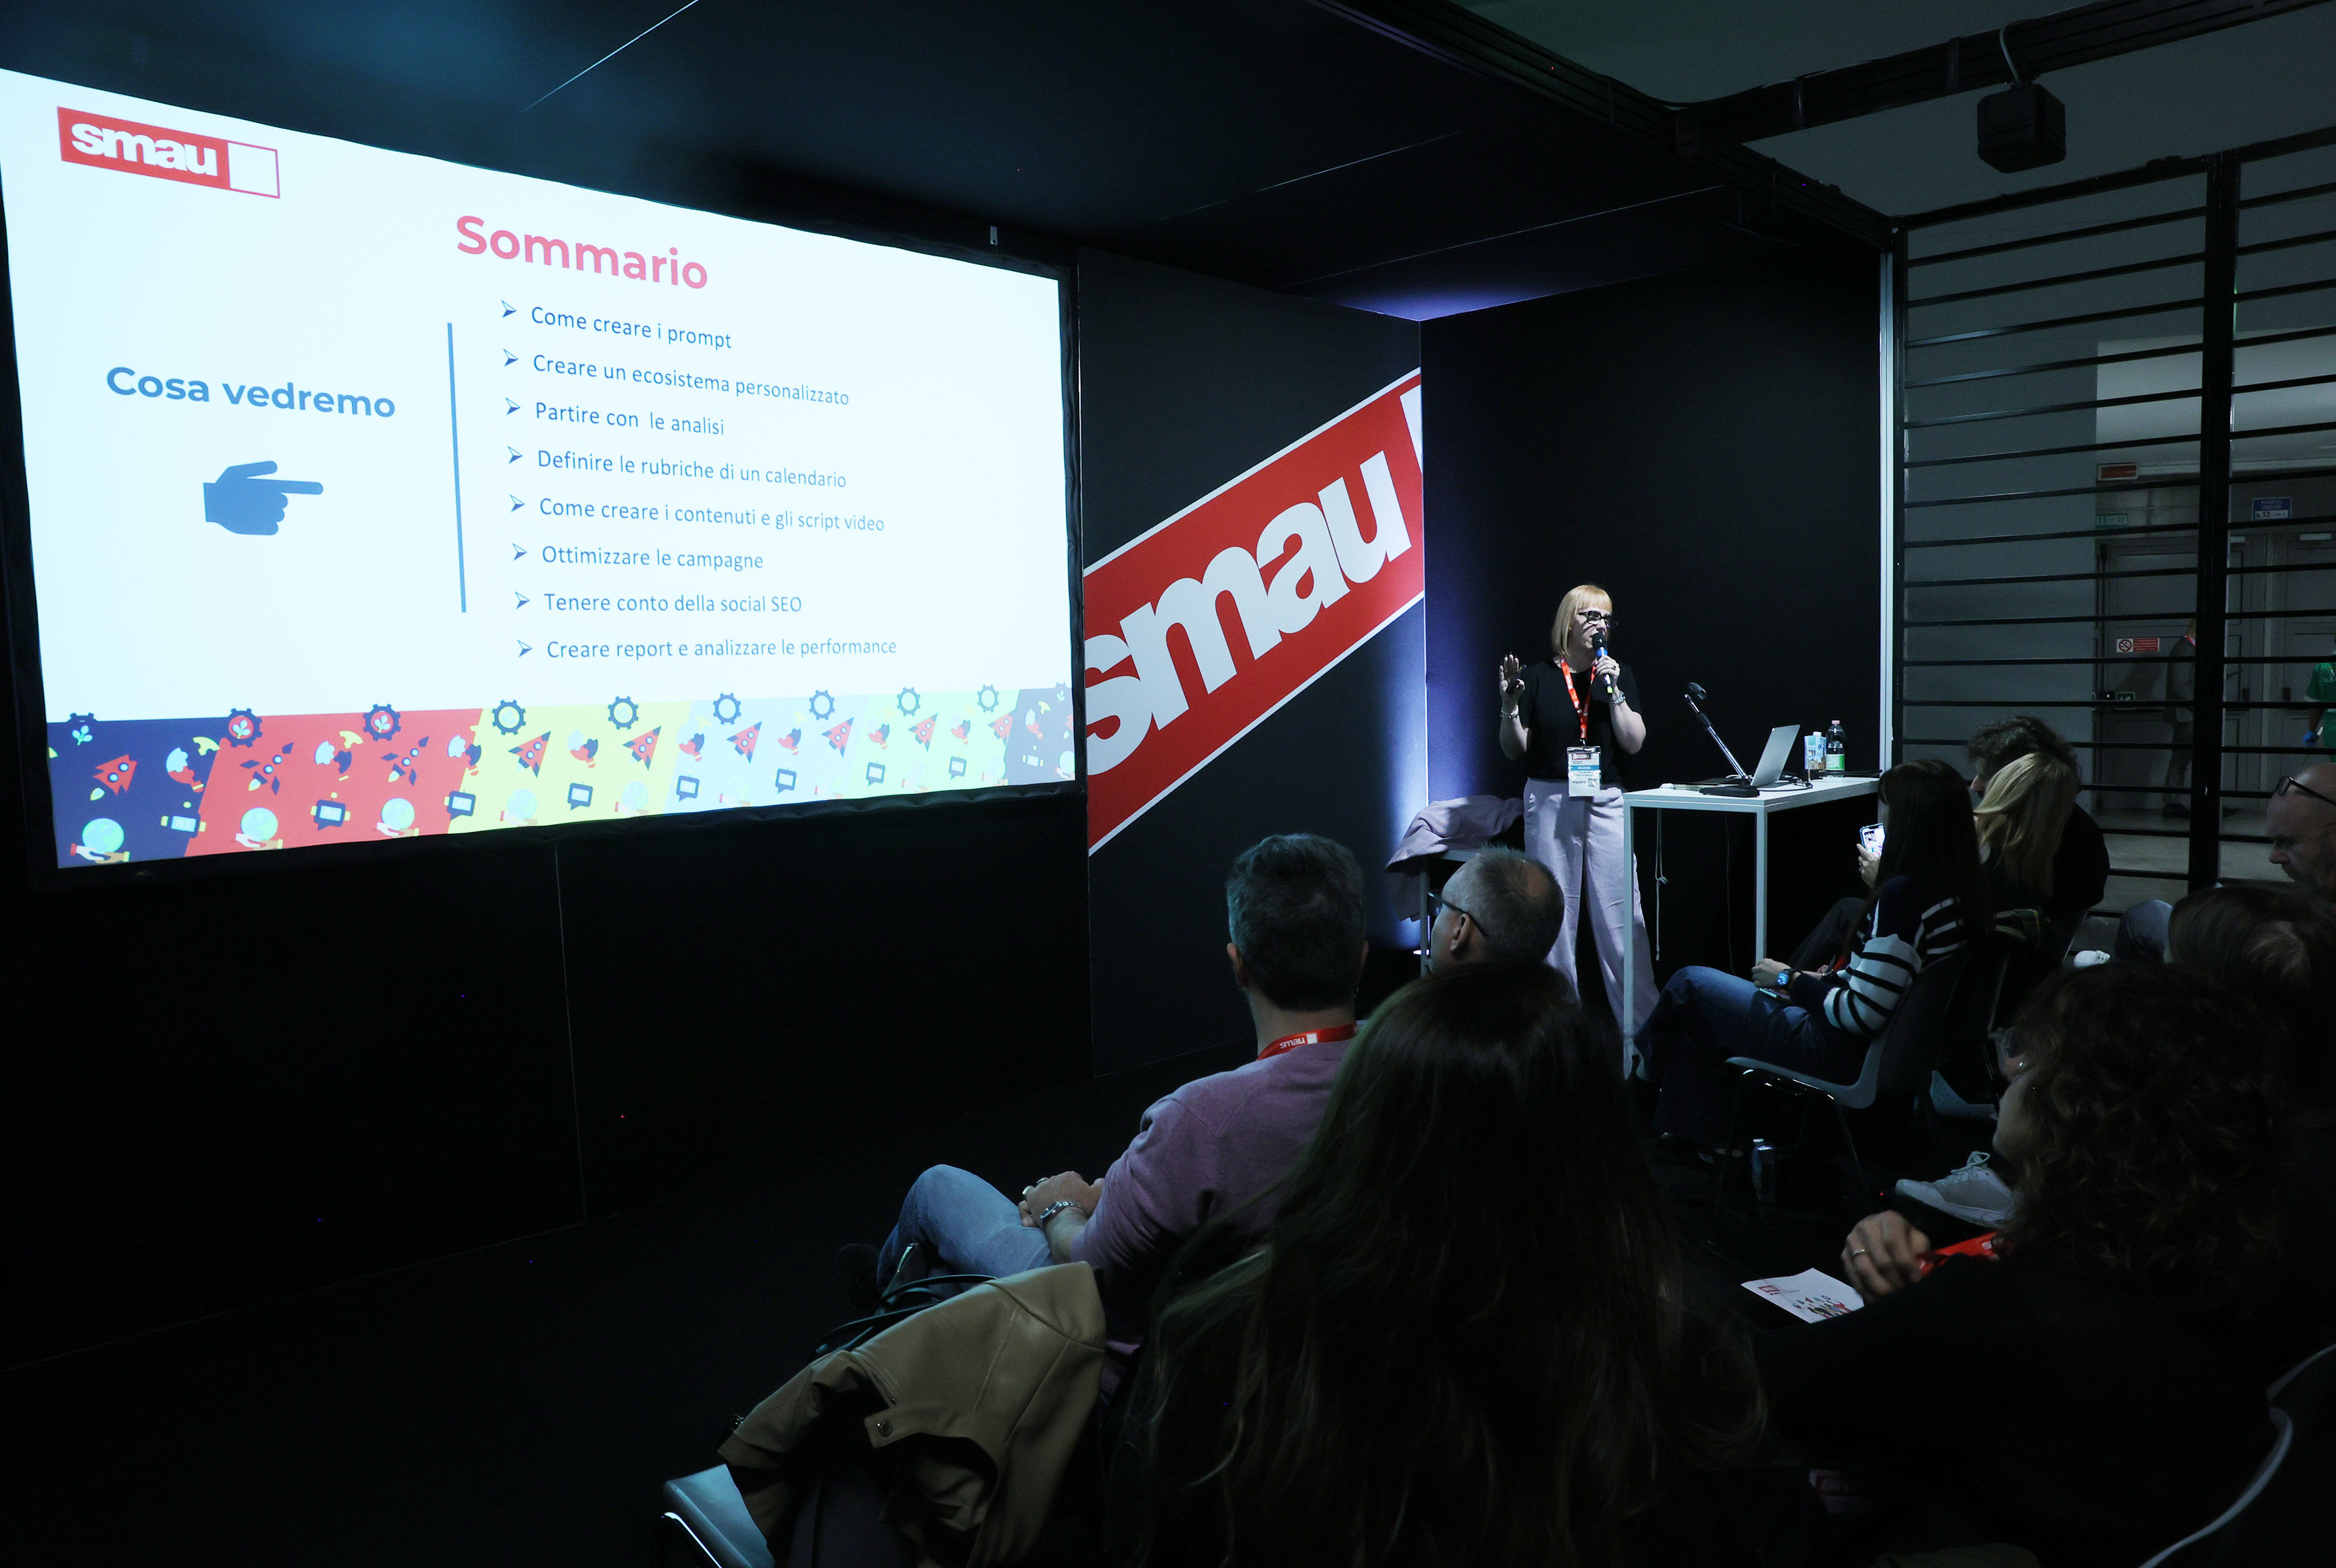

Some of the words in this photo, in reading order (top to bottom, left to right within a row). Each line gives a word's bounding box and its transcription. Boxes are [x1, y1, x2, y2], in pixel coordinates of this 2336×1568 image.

[71, 123, 218, 177] smau
[456, 215, 708, 290] Sommario
[531, 306, 587, 330] Come
[593, 318, 652, 338] creare
[667, 328, 732, 352] prompt
[106, 366, 210, 403] Cosa
[221, 381, 396, 418] vedremo
[533, 354, 597, 378] Creare
[603, 366, 627, 381] un
[631, 369, 729, 392] ecosistema
[736, 381, 849, 406] personalizzato
[535, 401, 600, 424] Partire
[606, 412, 639, 428] con
[649, 411, 665, 430] le
[671, 416, 724, 436] analisi
[537, 449, 613, 472] Definire
[619, 454, 635, 474] le
[641, 457, 714, 479] rubriche
[719, 462, 734, 480] di
[740, 468, 760, 482] un
[765, 467, 846, 488] calendario
[539, 497, 595, 518] Come
[601, 504, 659, 520] creare
[675, 507, 756, 525] contenuti
[761, 513, 771, 526] e
[775, 509, 793, 530] gli
[798, 512, 840, 532] script
[844, 514, 884, 532] video
[542, 545, 650, 566] Ottimizzare
[656, 548, 672, 566] le
[677, 553, 764, 572] campagne
[543, 593, 611, 611] Tenere
[617, 595, 669, 612] conto
[674, 594, 715, 612] della
[720, 595, 766, 613] social
[771, 596, 802, 613] SEO
[1085, 450, 1412, 775] smau
[547, 641, 610, 659] Creare
[616, 641, 673, 662] report
[678, 643, 689, 657] e
[694, 639, 777, 657] analizzare
[781, 638, 795, 655] le
[800, 637, 896, 659] performance
[1279, 1037, 1305, 1049] smau
